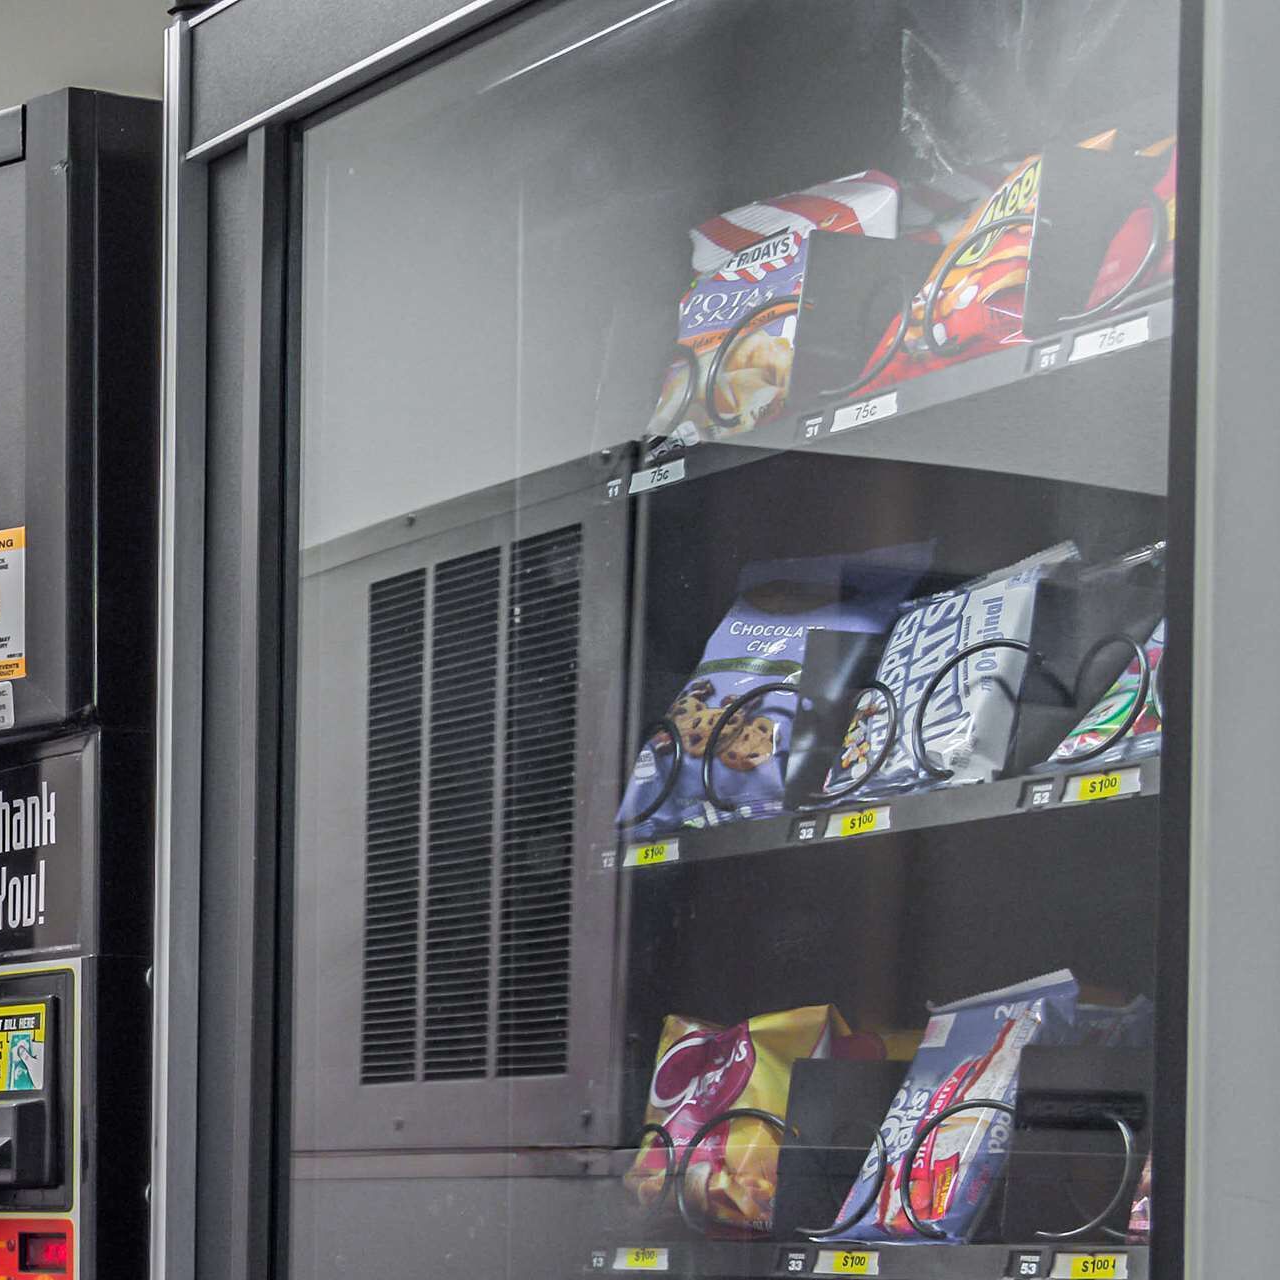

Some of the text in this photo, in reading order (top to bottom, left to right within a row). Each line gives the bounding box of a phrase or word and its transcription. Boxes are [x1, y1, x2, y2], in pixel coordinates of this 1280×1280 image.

[806, 423, 820, 438] 31
[729, 620, 825, 638] CHOCOLA
[0, 635, 11, 644] MAY
[1033, 791, 1050, 805] 52
[799, 828, 814, 840] 32
[4, 1018, 17, 1030] BILL
[18, 1016, 36, 1029] HERE
[788, 1260, 803, 1271] 33
[1019, 1262, 1037, 1275] 53
